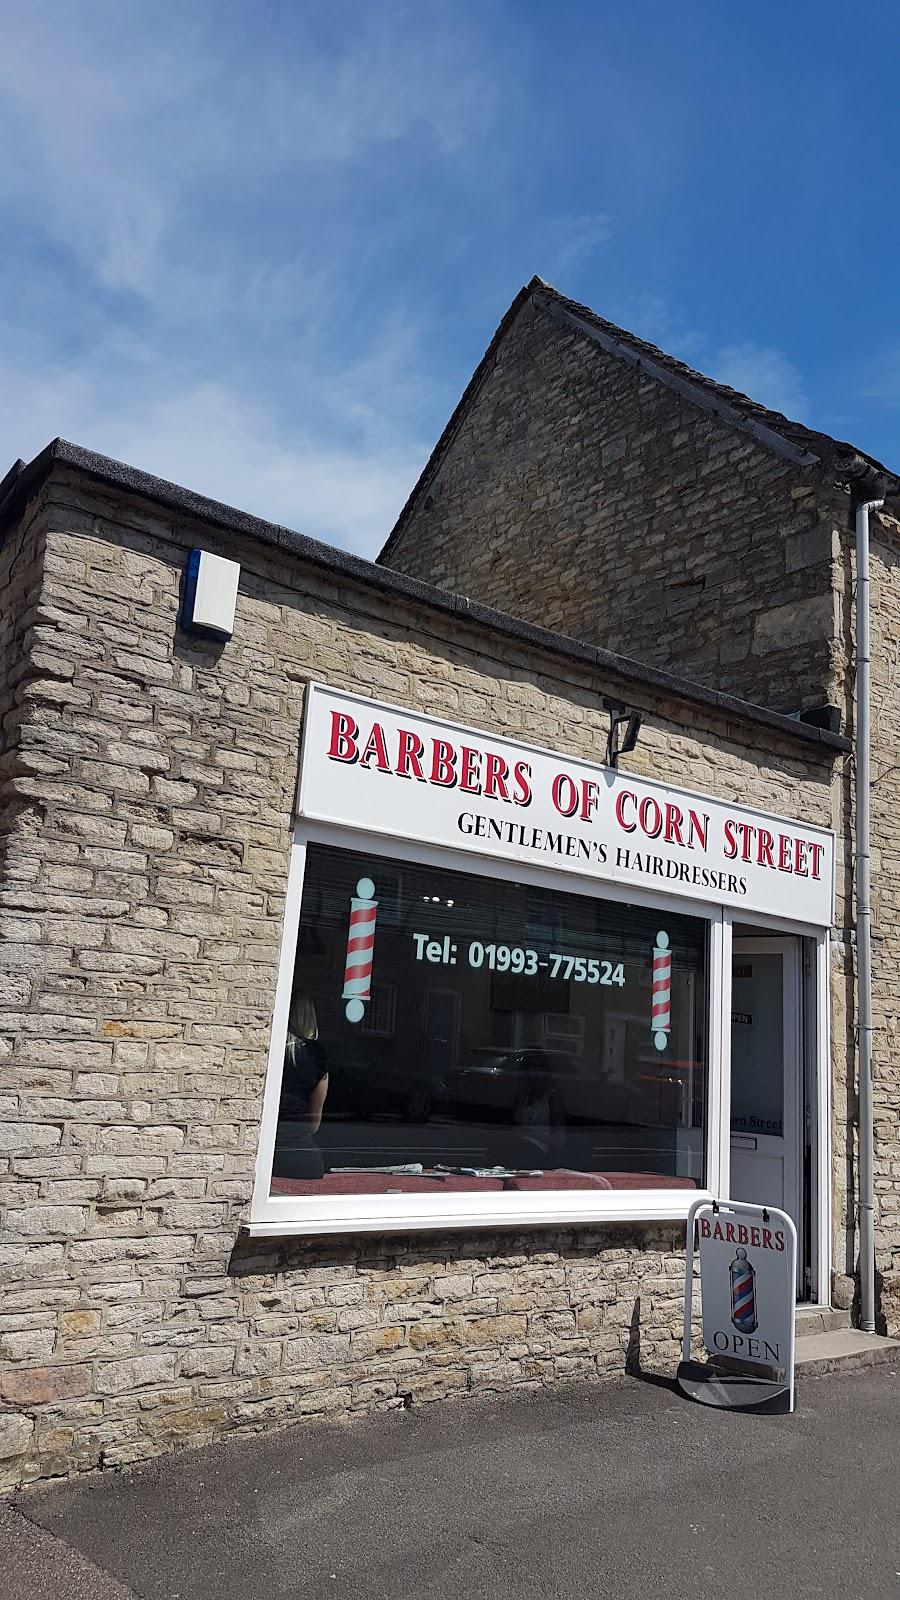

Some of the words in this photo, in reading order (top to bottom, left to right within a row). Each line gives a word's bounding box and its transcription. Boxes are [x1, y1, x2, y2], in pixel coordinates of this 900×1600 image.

[326, 710, 532, 807] BARBERS
[551, 773, 600, 822] OF
[615, 790, 710, 852] CORN
[723, 819, 825, 880] STREET
[457, 812, 608, 863] GENTLEMEN'S
[615, 847, 747, 894] HAIRDRESSERS
[413, 933, 457, 964] Tel:
[468, 941, 626, 987] 01993-775524
[750, 1115, 783, 1130] Street
[700, 1218, 785, 1251] BARBERS
[713, 1331, 780, 1362] OPEN
